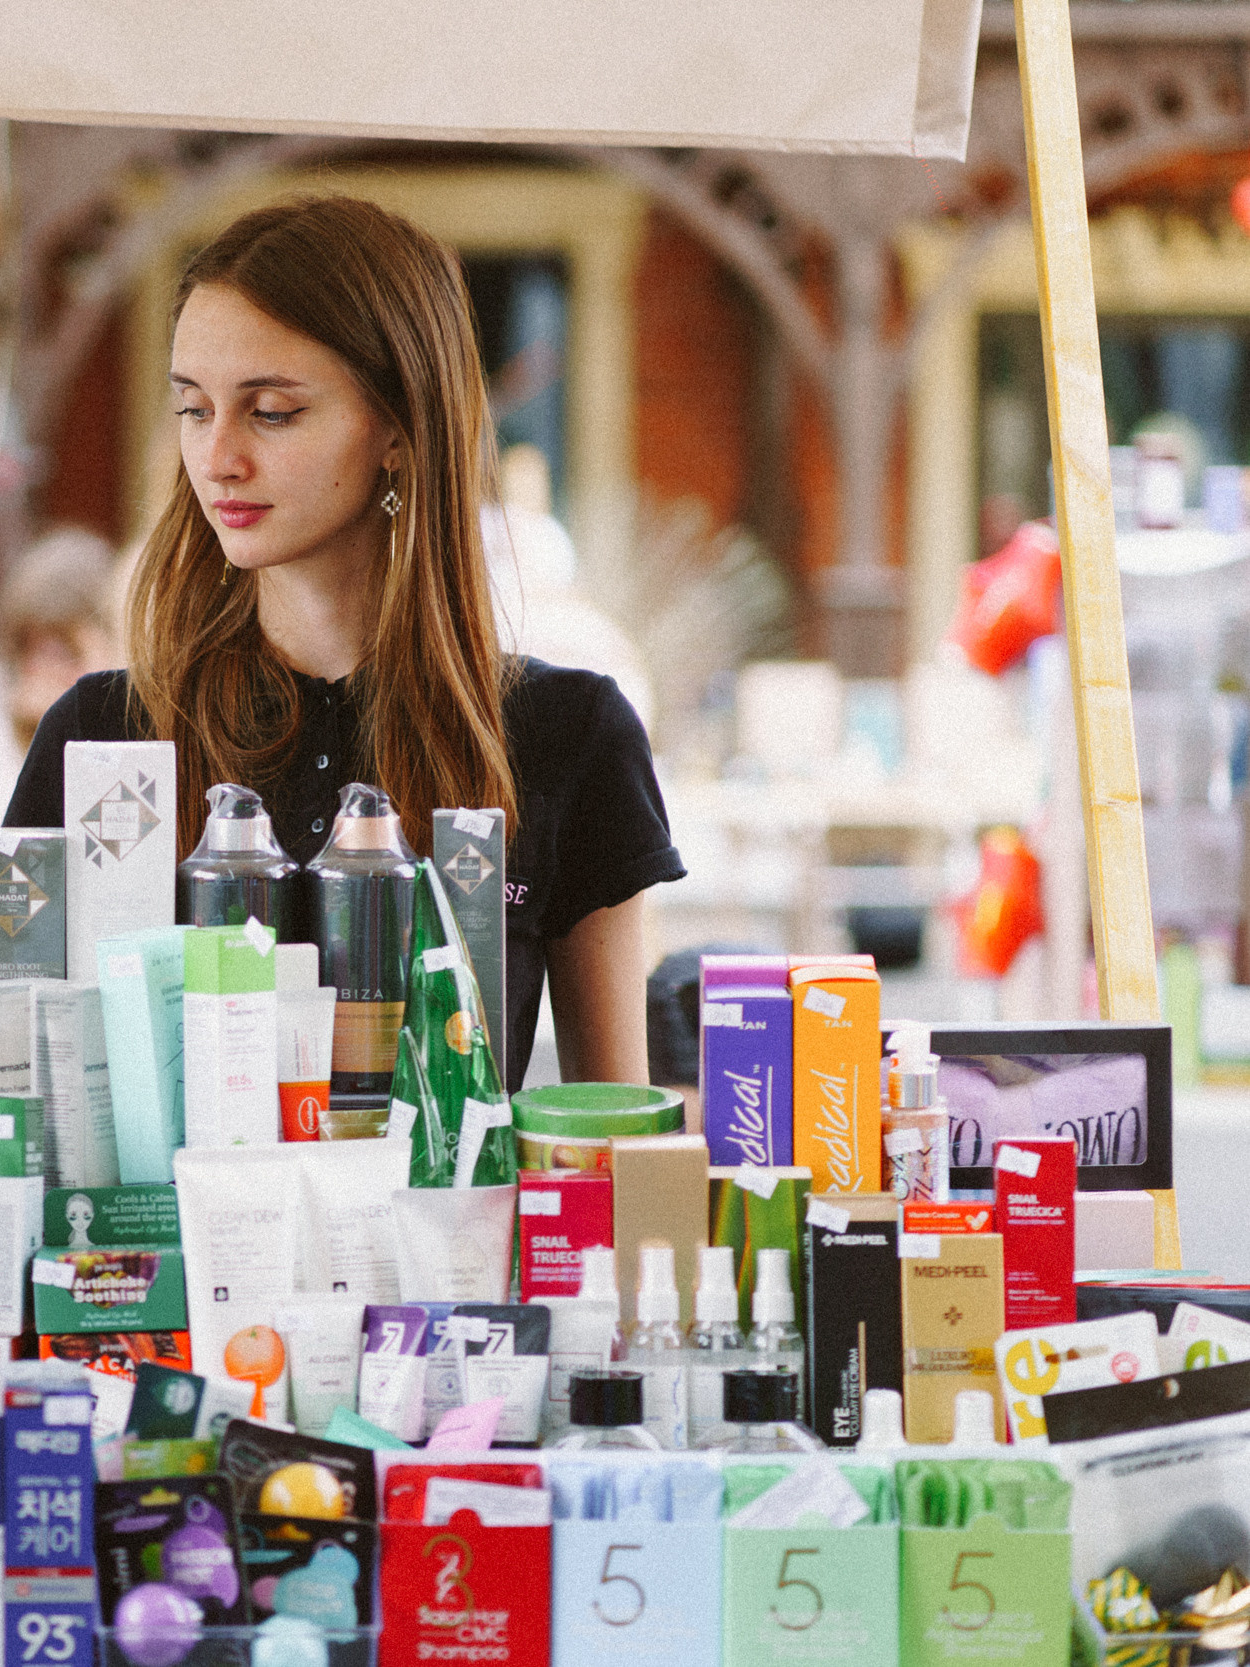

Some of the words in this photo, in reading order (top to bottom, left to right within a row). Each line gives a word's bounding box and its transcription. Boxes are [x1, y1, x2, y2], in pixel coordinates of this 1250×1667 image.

[1007, 1193, 1040, 1204] SNAIL
[109, 1214, 141, 1223] around
[142, 1213, 157, 1222] the
[530, 1236, 572, 1249] SNAIL
[73, 1276, 146, 1290] Artichoke
[913, 1265, 989, 1279] MEDI-PEEL
[73, 1290, 147, 1304] Soothing
[81, 1357, 150, 1371] CACA
[849, 1347, 859, 1382] CREAM
[849, 1382, 859, 1399] EYE
[833, 1407, 850, 1438] EYE
[850, 1399, 860, 1438] VOLUMY
[16, 1489, 82, 1523] 치석
[16, 1525, 82, 1558] 케어
[592, 1544, 645, 1626] 5
[769, 1548, 824, 1631] 5
[942, 1551, 997, 1631] 5
[16, 1611, 87, 1661] 93
[456, 1626, 509, 1643] CMC
